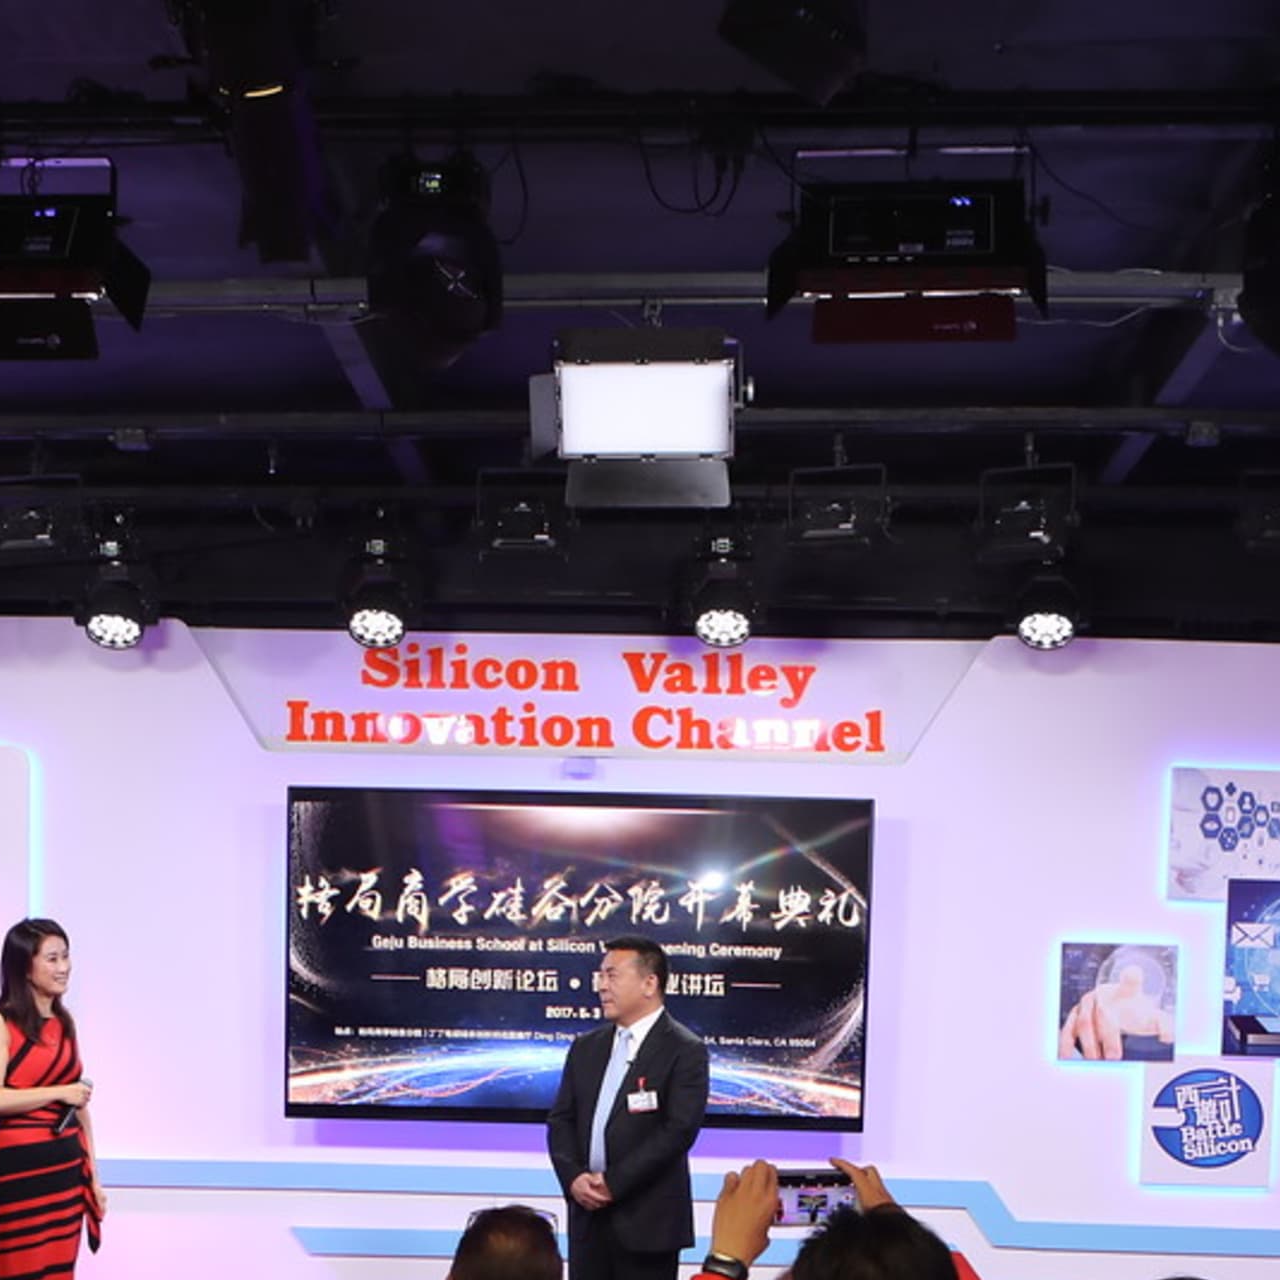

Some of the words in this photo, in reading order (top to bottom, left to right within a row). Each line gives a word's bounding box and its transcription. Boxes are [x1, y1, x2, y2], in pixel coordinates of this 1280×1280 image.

[361, 643, 580, 692] Silicon
[621, 651, 817, 709] Valley
[285, 700, 615, 748] Innovation
[631, 705, 886, 752] Channel
[372, 934, 404, 951] Geju
[407, 935, 473, 950] Business
[476, 936, 525, 951] School
[528, 939, 544, 952] at
[546, 938, 596, 953] Silicon
[709, 943, 783, 960] Ceremony
[1180, 1120, 1243, 1144] Battle
[1183, 1138, 1254, 1161] Silicon
